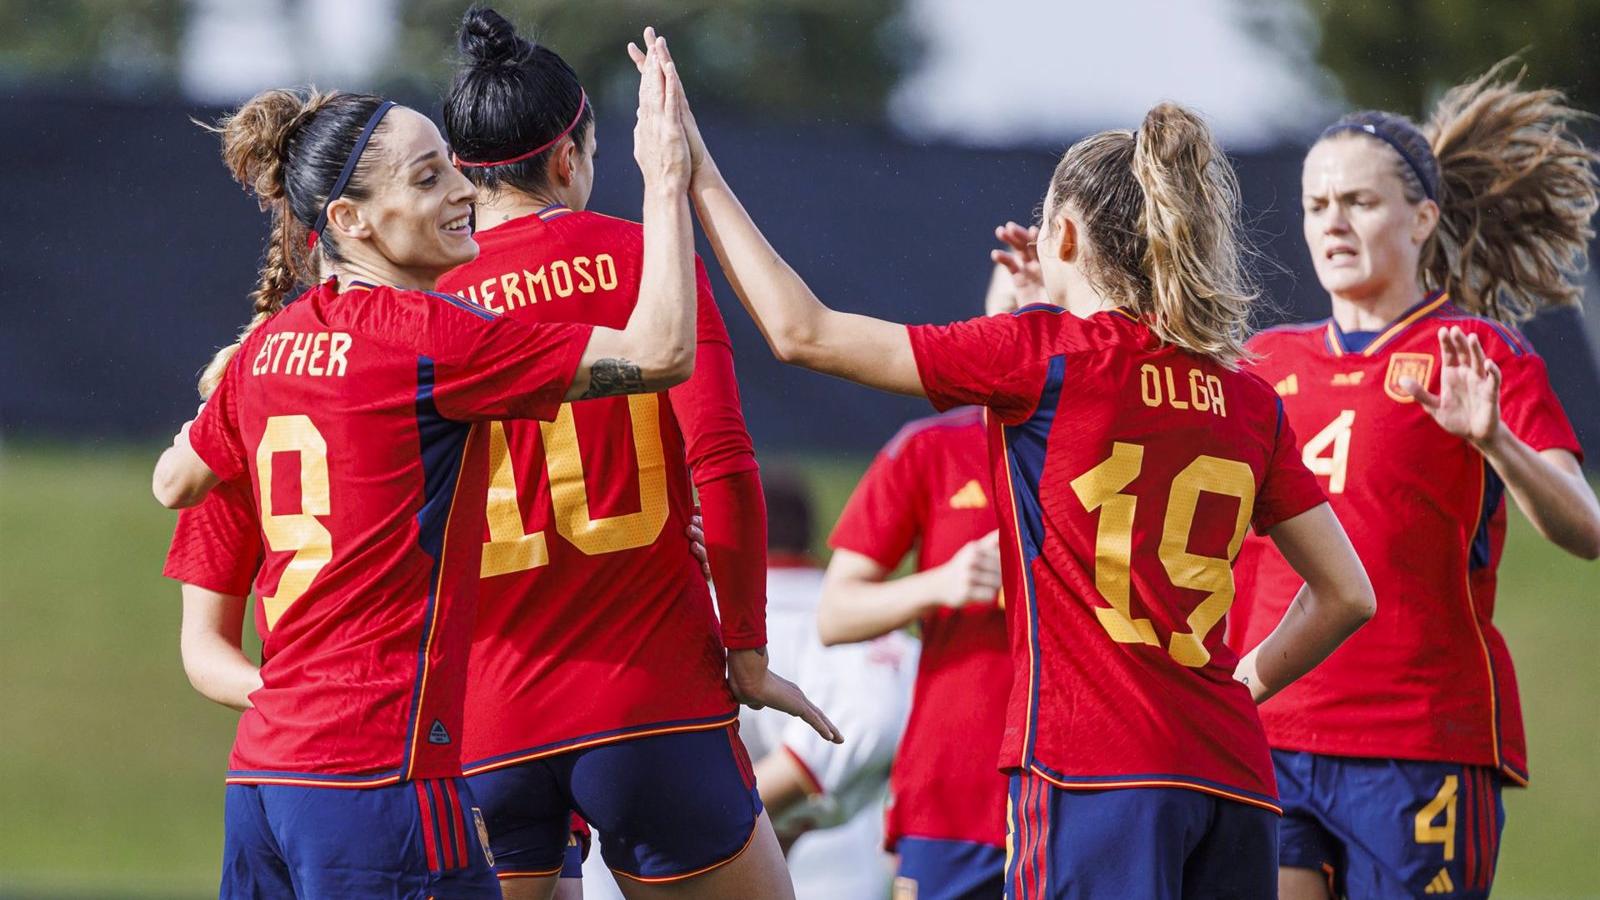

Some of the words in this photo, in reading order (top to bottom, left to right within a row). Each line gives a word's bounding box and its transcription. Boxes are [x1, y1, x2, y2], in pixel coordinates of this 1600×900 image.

[253, 331, 353, 377] ESTHER
[1141, 363, 1227, 418] OLGA
[480, 392, 670, 579] 10
[1301, 409, 1356, 494] 4
[256, 414, 333, 633] 9
[1070, 441, 1256, 668] 19
[1414, 774, 1458, 861] 4
